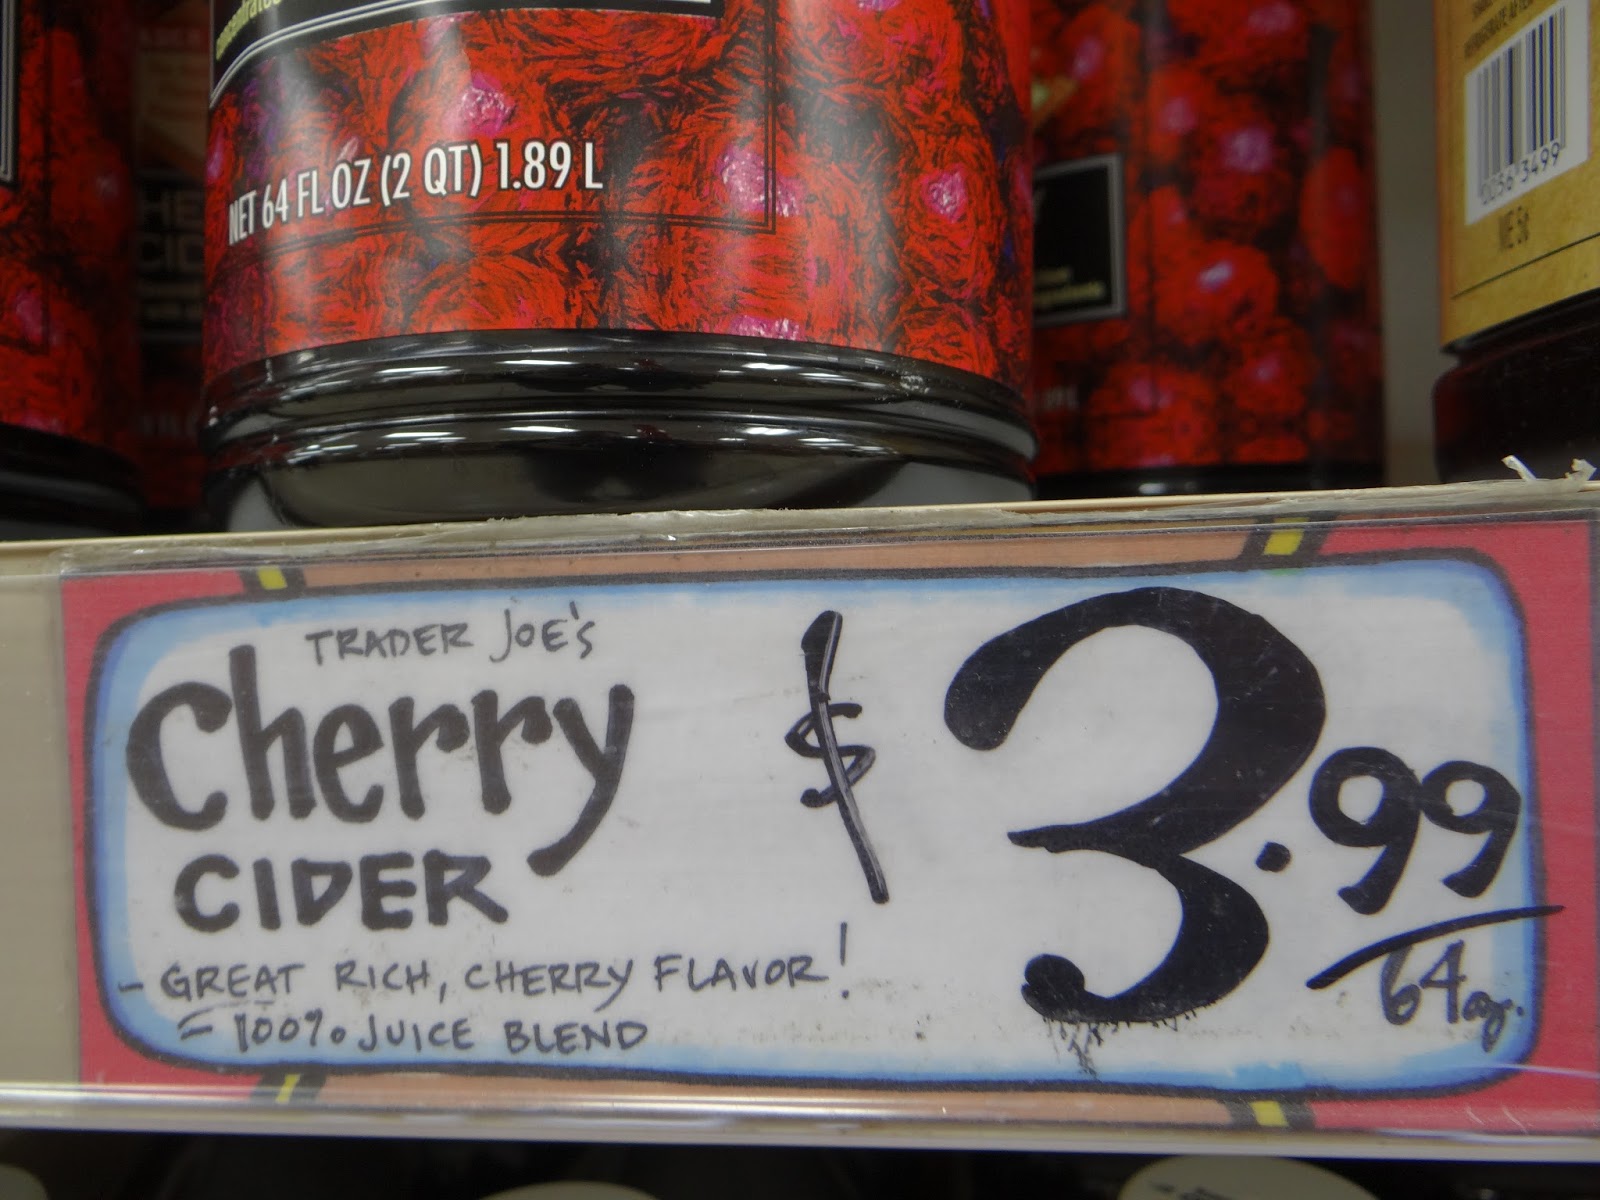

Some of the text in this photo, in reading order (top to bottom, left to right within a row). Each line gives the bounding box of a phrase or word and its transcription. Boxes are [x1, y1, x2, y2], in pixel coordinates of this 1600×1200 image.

[228, 189, 258, 246] NET
[261, 177, 290, 230] 64
[297, 169, 325, 219] FL
[331, 157, 372, 210] OZ
[380, 151, 412, 208] (2
[423, 142, 483, 199] QT)
[495, 140, 572, 190] 1.89
[584, 141, 604, 190] L
[304, 622, 474, 667] TRADER
[125, 644, 636, 877] Cherry
[784, 610, 890, 904] $
[173, 849, 509, 933] CIDER
[160, 961, 306, 1002] GREAT
[333, 959, 449, 1004] RICH,
[464, 959, 635, 1013] CHERRY
[654, 921, 851, 1000] FLAVOR!
[233, 1007, 347, 1053] 100%
[357, 1014, 475, 1053] JUICE
[503, 1018, 649, 1056] BLEND
